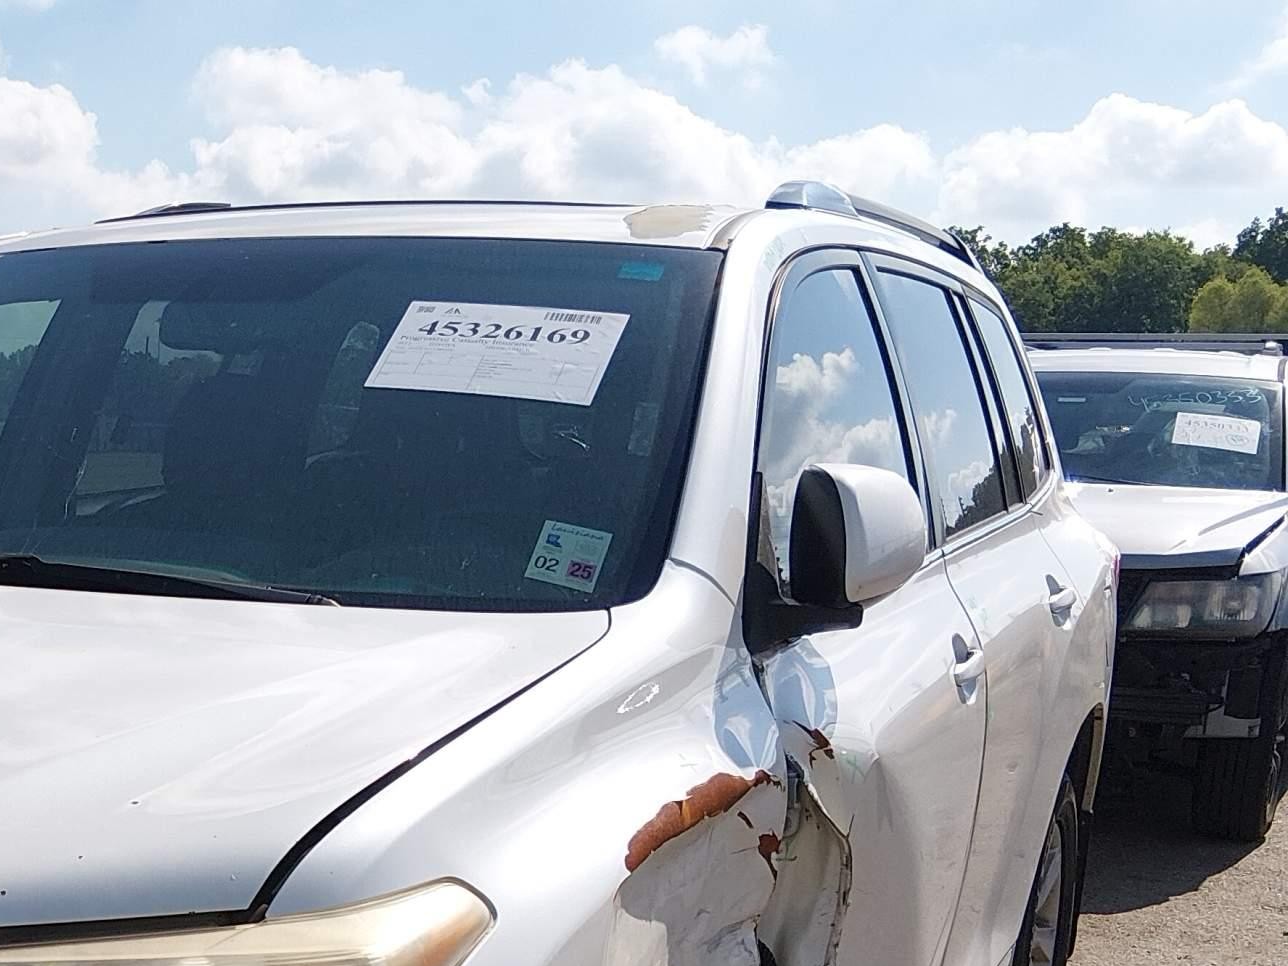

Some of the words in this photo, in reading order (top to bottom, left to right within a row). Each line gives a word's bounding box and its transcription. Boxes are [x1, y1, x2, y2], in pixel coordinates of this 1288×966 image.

[418, 320, 591, 345] 45326169
[534, 555, 560, 573] 02
[569, 562, 593, 580] 25
